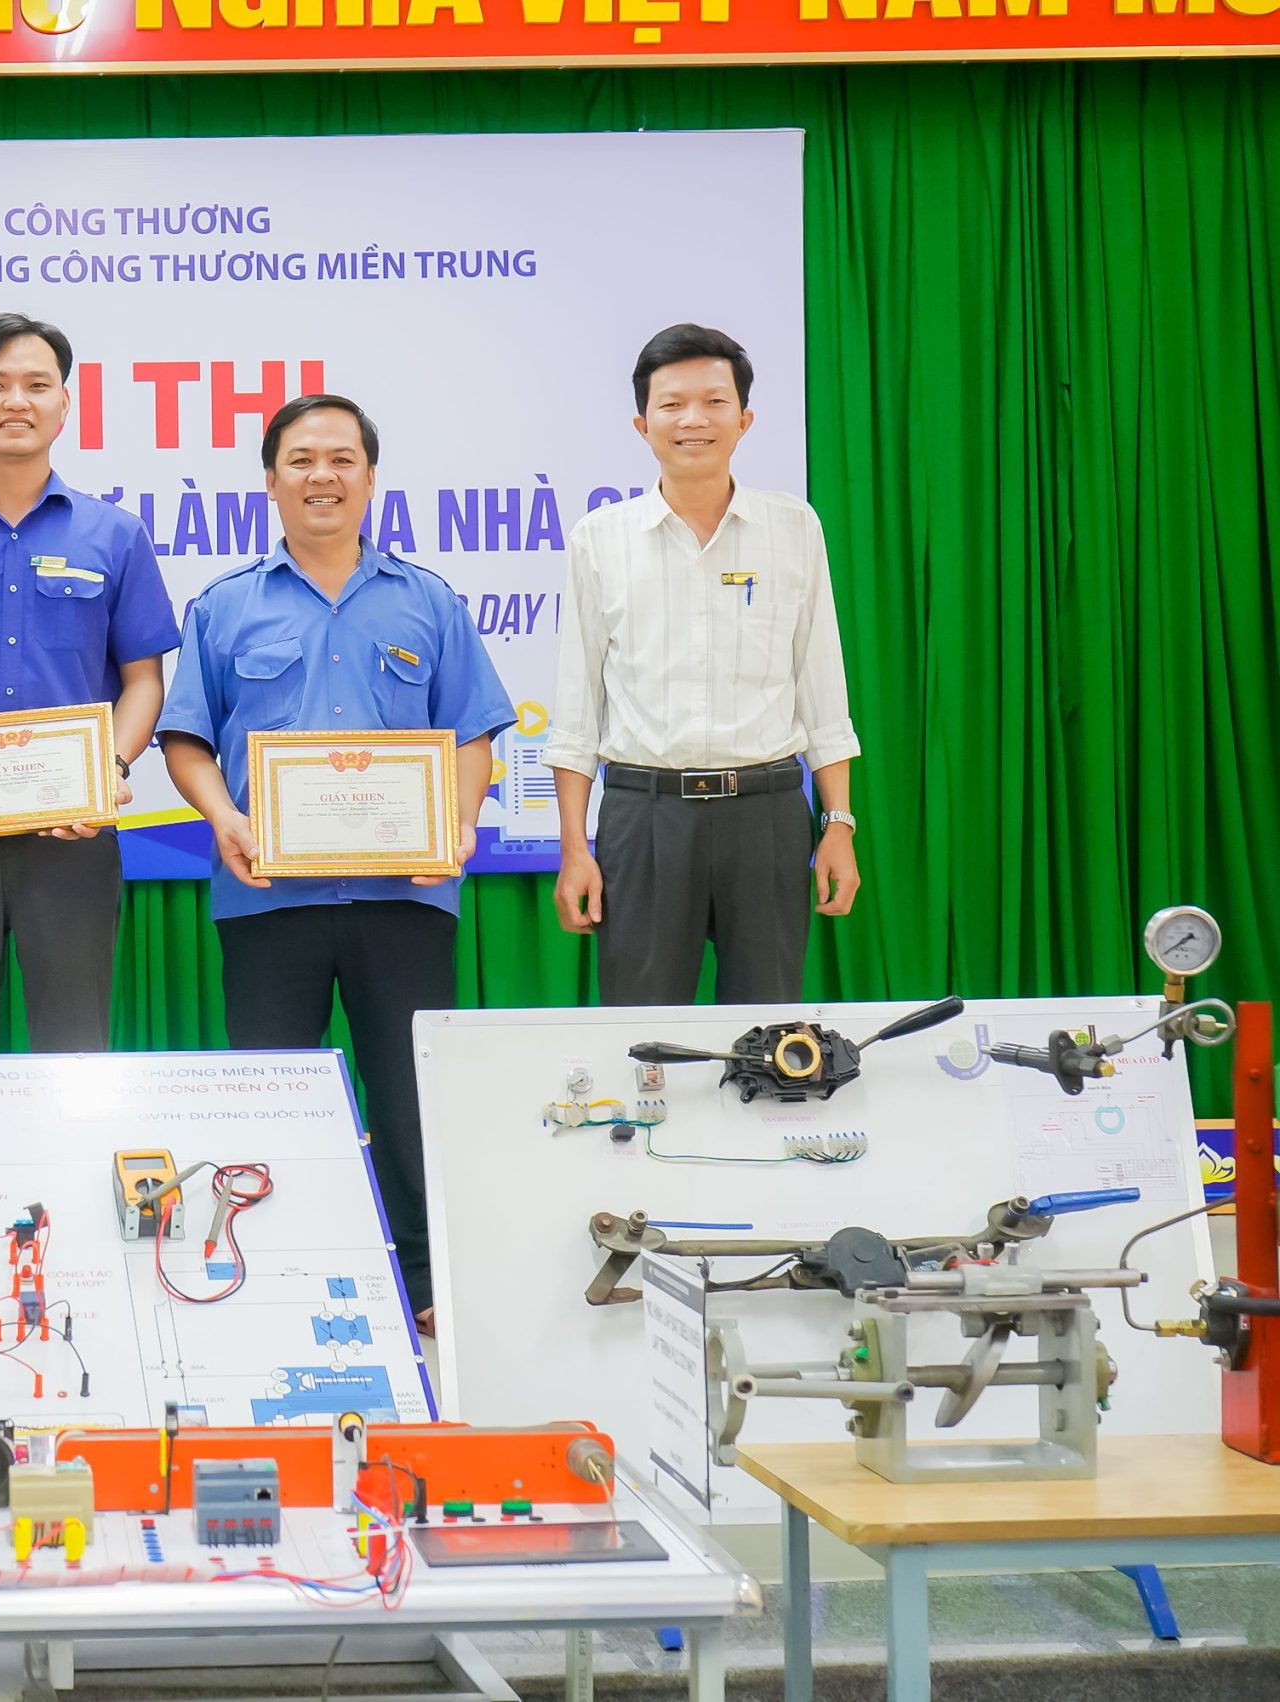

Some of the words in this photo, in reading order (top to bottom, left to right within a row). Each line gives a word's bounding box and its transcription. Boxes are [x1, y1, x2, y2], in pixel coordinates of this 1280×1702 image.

[4, 202, 106, 236] CÔNG
[113, 203, 271, 235] THƯƠNG
[40, 250, 142, 283] CÔNG
[150, 249, 306, 282] THƯƠNG
[317, 243, 406, 280] MIỀN
[414, 249, 537, 279] TRUNG
[140, 478, 269, 556] LÀM
[438, 473, 565, 552] NHÀ
[477, 593, 546, 642] DẠY
[352, 792, 384, 802] KHEN
[270, 1065, 333, 1076] TRUNG
[190, 1110, 249, 1120] DƯƠNG
[304, 1109, 336, 1119] HUY
